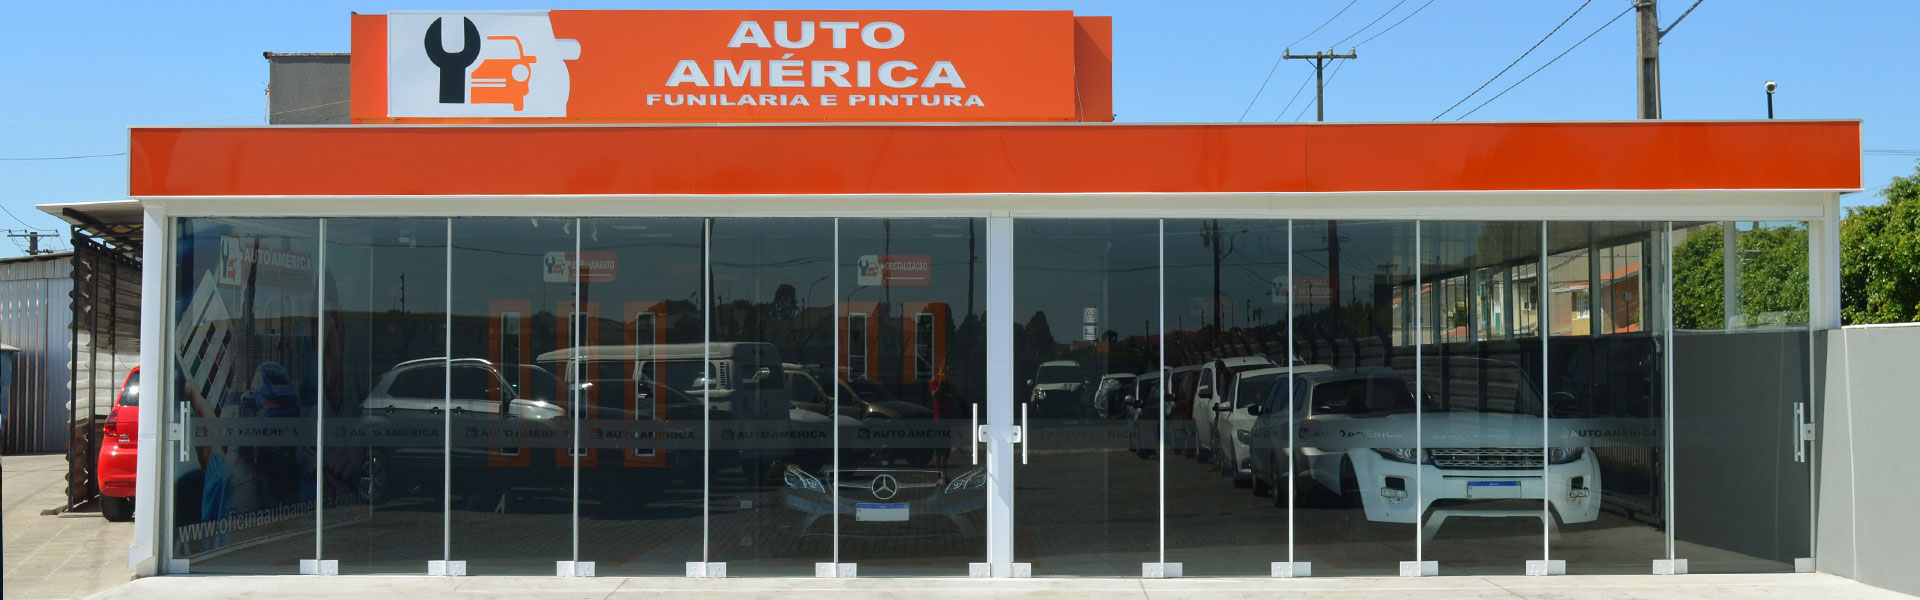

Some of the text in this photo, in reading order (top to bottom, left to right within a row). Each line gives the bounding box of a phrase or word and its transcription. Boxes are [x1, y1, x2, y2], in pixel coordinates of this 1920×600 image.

[727, 20, 905, 49] AUTO
[664, 53, 966, 88] AMÉRICA
[646, 94, 984, 107] FUNILARIA E PINTURA
